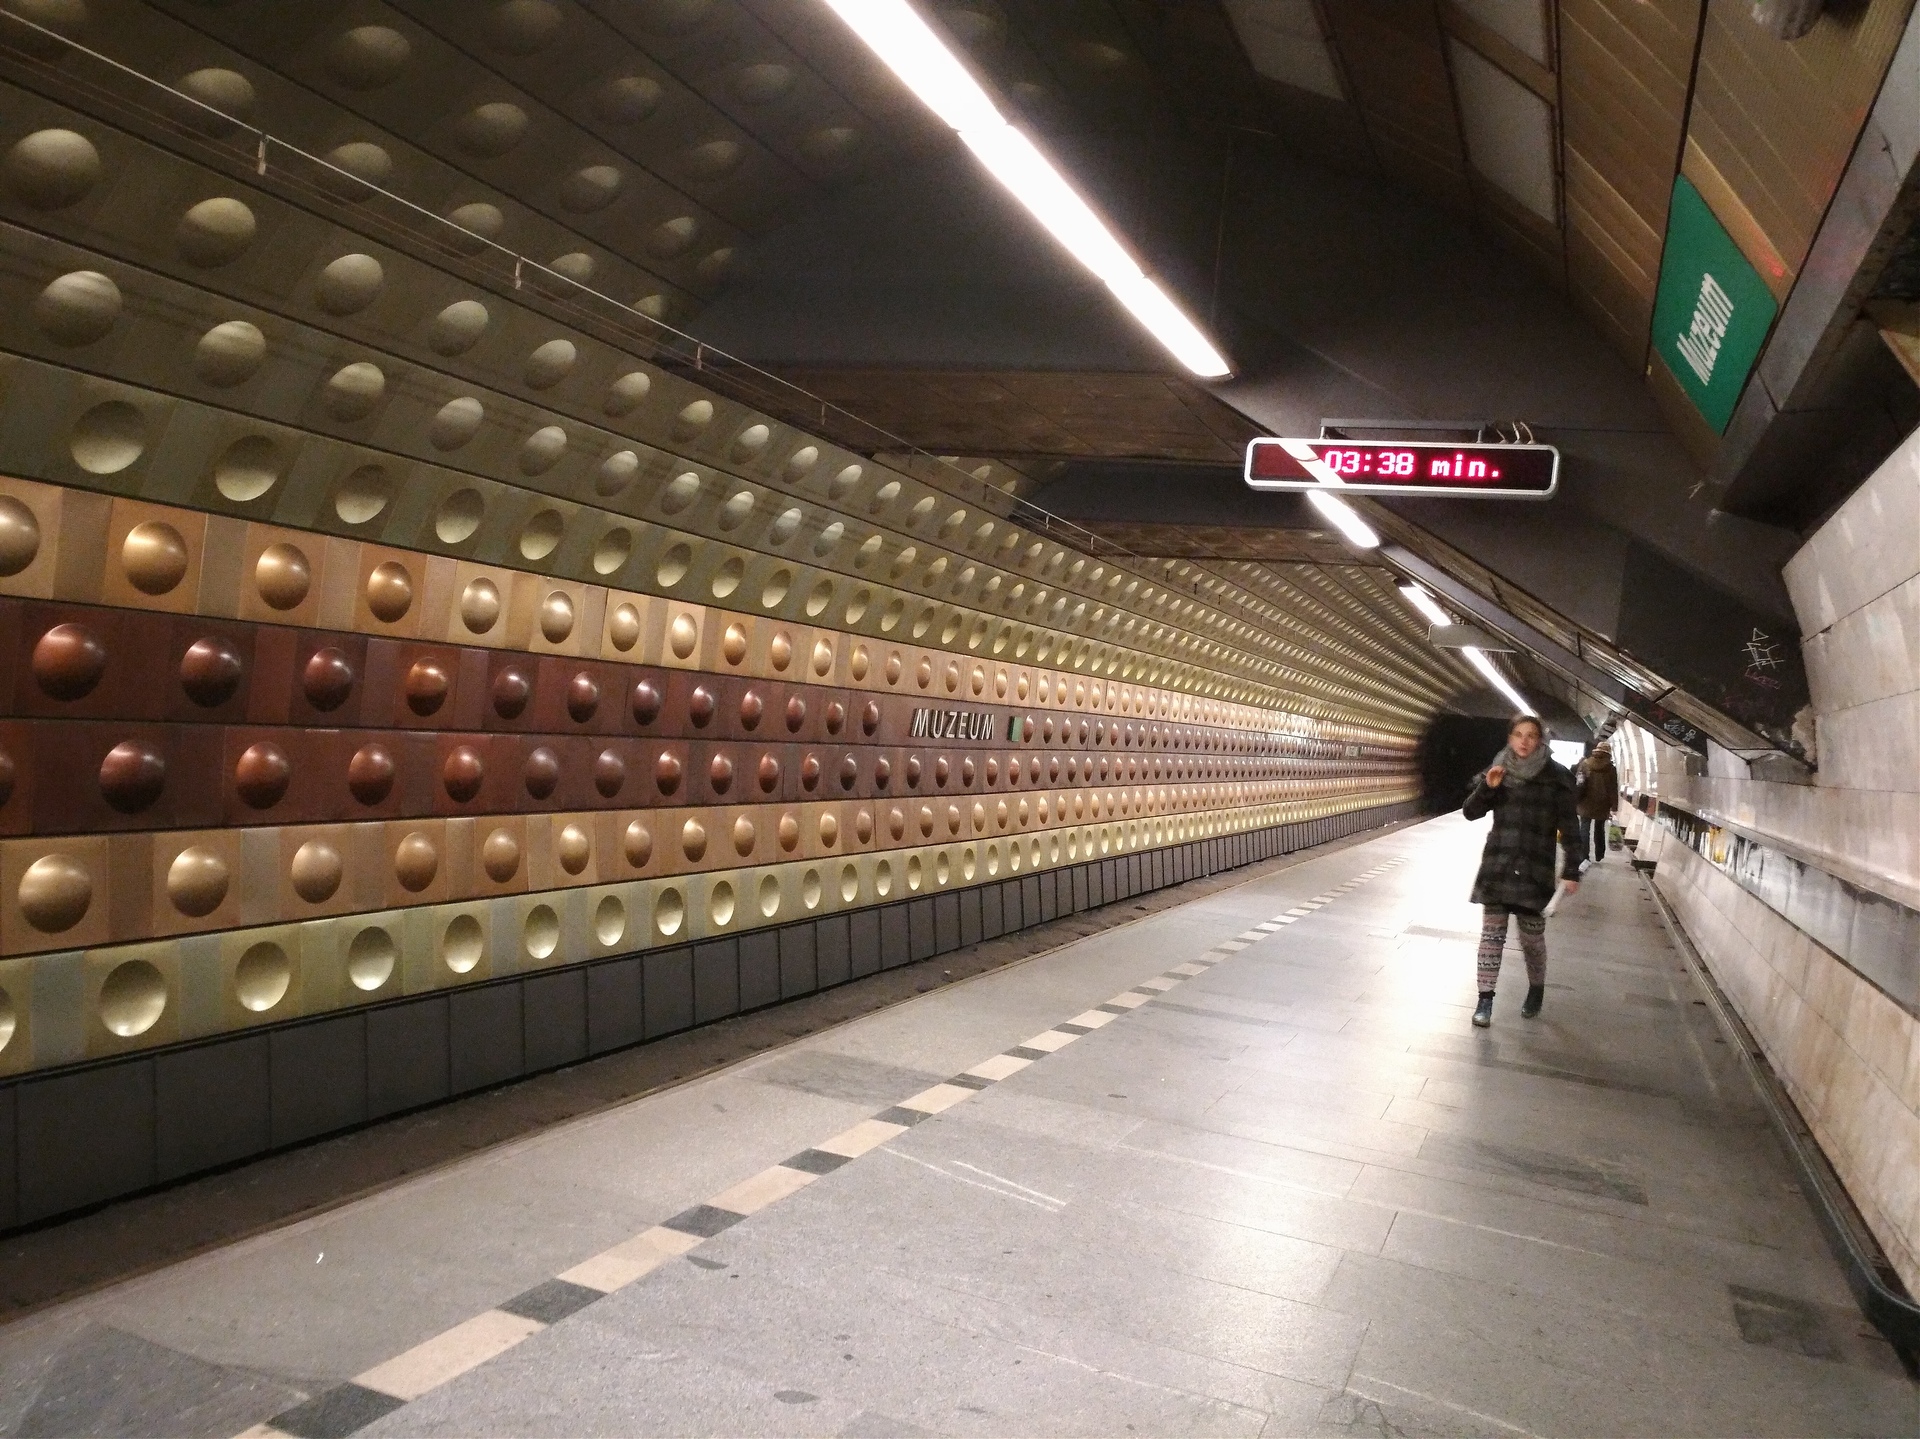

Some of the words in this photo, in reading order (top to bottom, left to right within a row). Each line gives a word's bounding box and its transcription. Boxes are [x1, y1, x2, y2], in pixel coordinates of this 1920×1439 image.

[1676, 272, 1735, 386] Muzeum
[1323, 450, 1415, 476] 03:38
[1431, 454, 1500, 478] min.
[911, 708, 995, 740] MUZEUM
